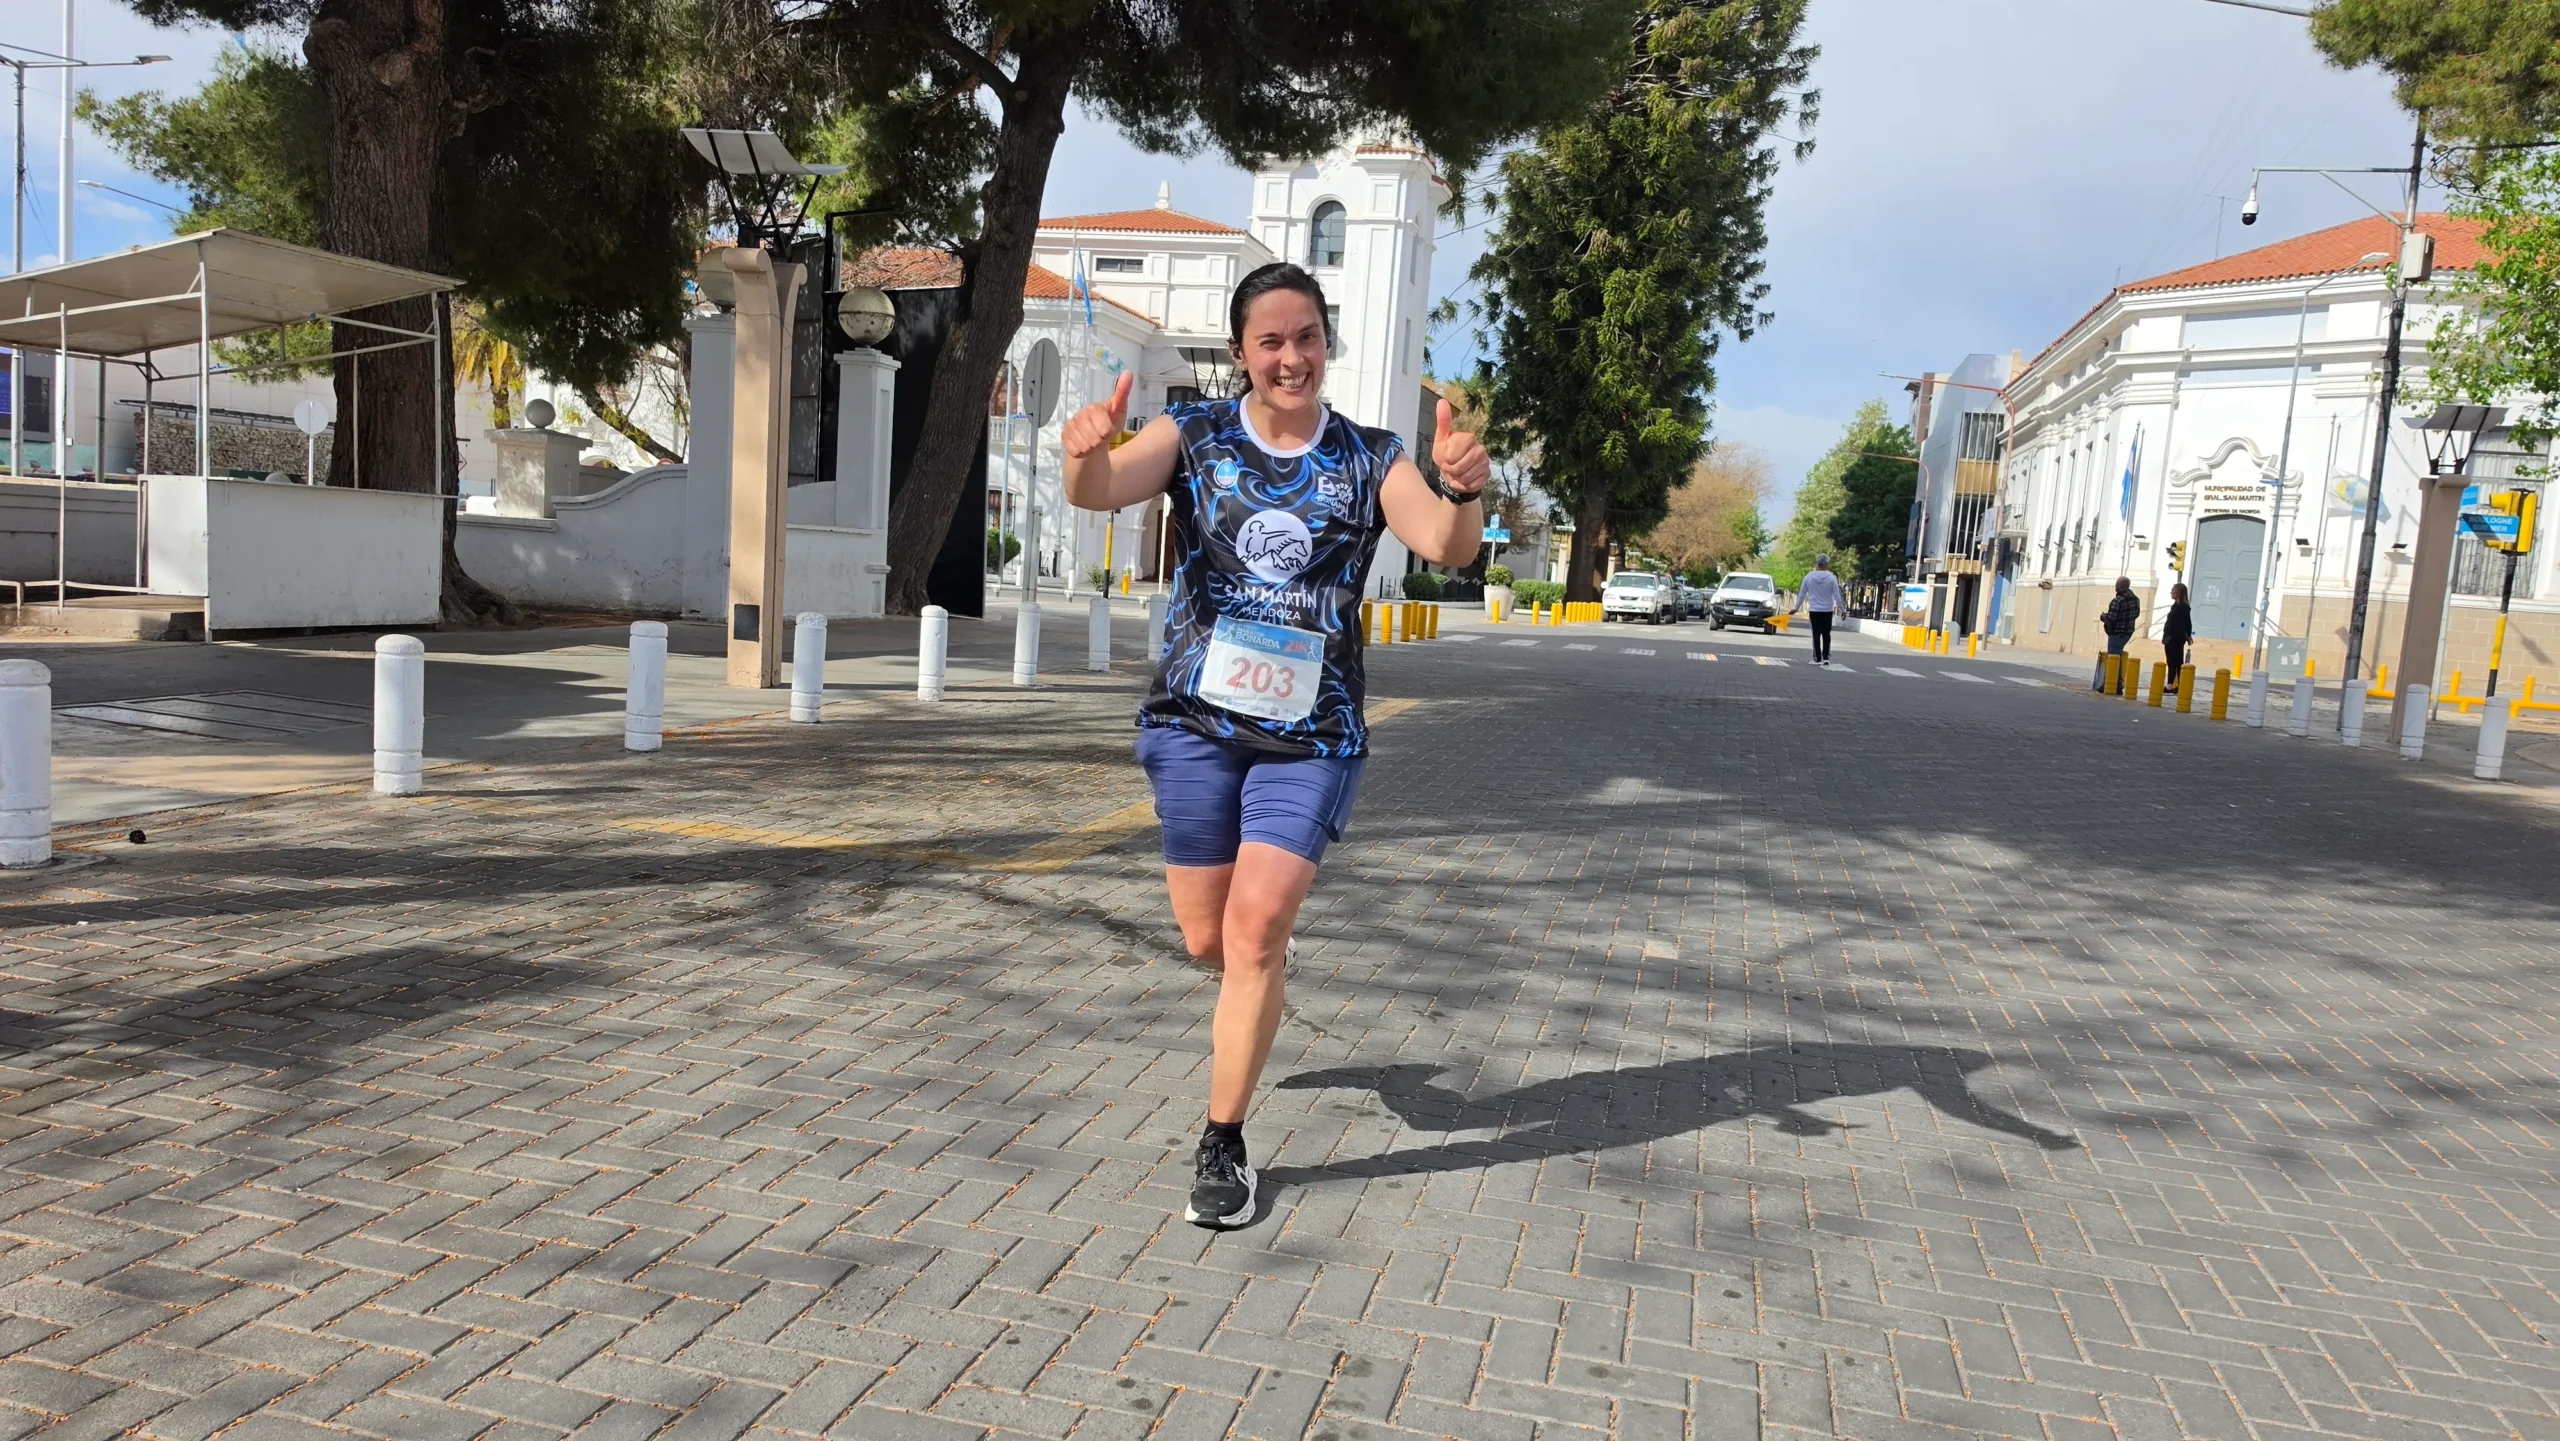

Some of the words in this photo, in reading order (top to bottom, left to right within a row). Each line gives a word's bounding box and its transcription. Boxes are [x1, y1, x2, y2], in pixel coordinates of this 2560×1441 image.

[2469, 516, 2513, 525] BOULOGNE
[1224, 584, 1256, 602] SAN
[1260, 587, 1317, 609] MARTÍN
[1242, 606, 1302, 621] MENDOZA
[1235, 631, 1280, 649] BONARDA
[1226, 657, 1295, 698] 203
